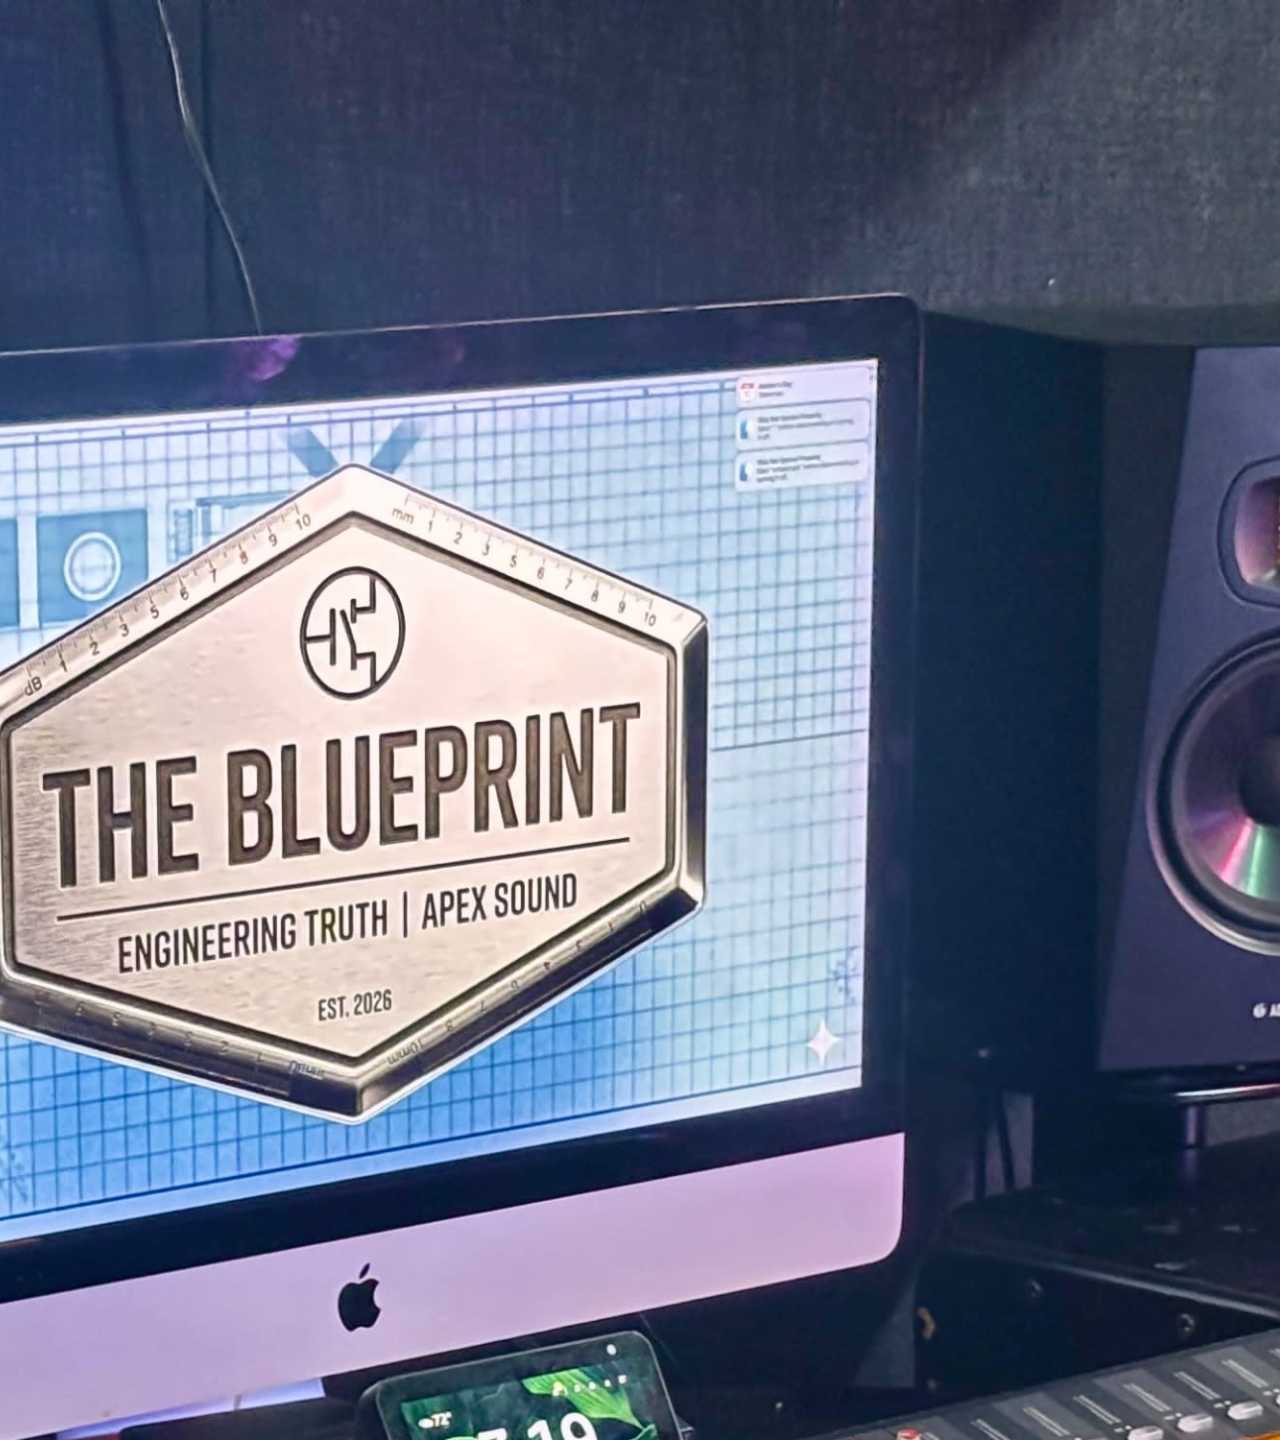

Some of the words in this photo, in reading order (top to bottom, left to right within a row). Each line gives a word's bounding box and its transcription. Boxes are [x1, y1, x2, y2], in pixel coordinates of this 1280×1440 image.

[24, 675, 43, 696] dB
[89, 641, 100, 656] 2
[119, 623, 130, 638] 3
[149, 606, 160, 620] 5
[179, 587, 189, 601] 6
[209, 567, 219, 583] 7
[268, 533, 278, 547] 9
[295, 514, 312, 529] 10
[391, 506, 415, 525] mm
[426, 519, 433, 531] 1
[452, 531, 463, 545] 2
[536, 566, 545, 580] 6
[590, 589, 599, 603] 8
[617, 600, 626, 614] 9
[643, 611, 657, 627] 10
[42, 755, 200, 888] THE
[227, 702, 641, 866] BLUEPRINT
[118, 913, 297, 973] ENGINEERING
[304, 900, 388, 947] TRUTH
[422, 884, 486, 928] APEX
[494, 872, 578, 919] SOUND
[318, 997, 350, 1021] EST.
[354, 989, 393, 1016] 2026
